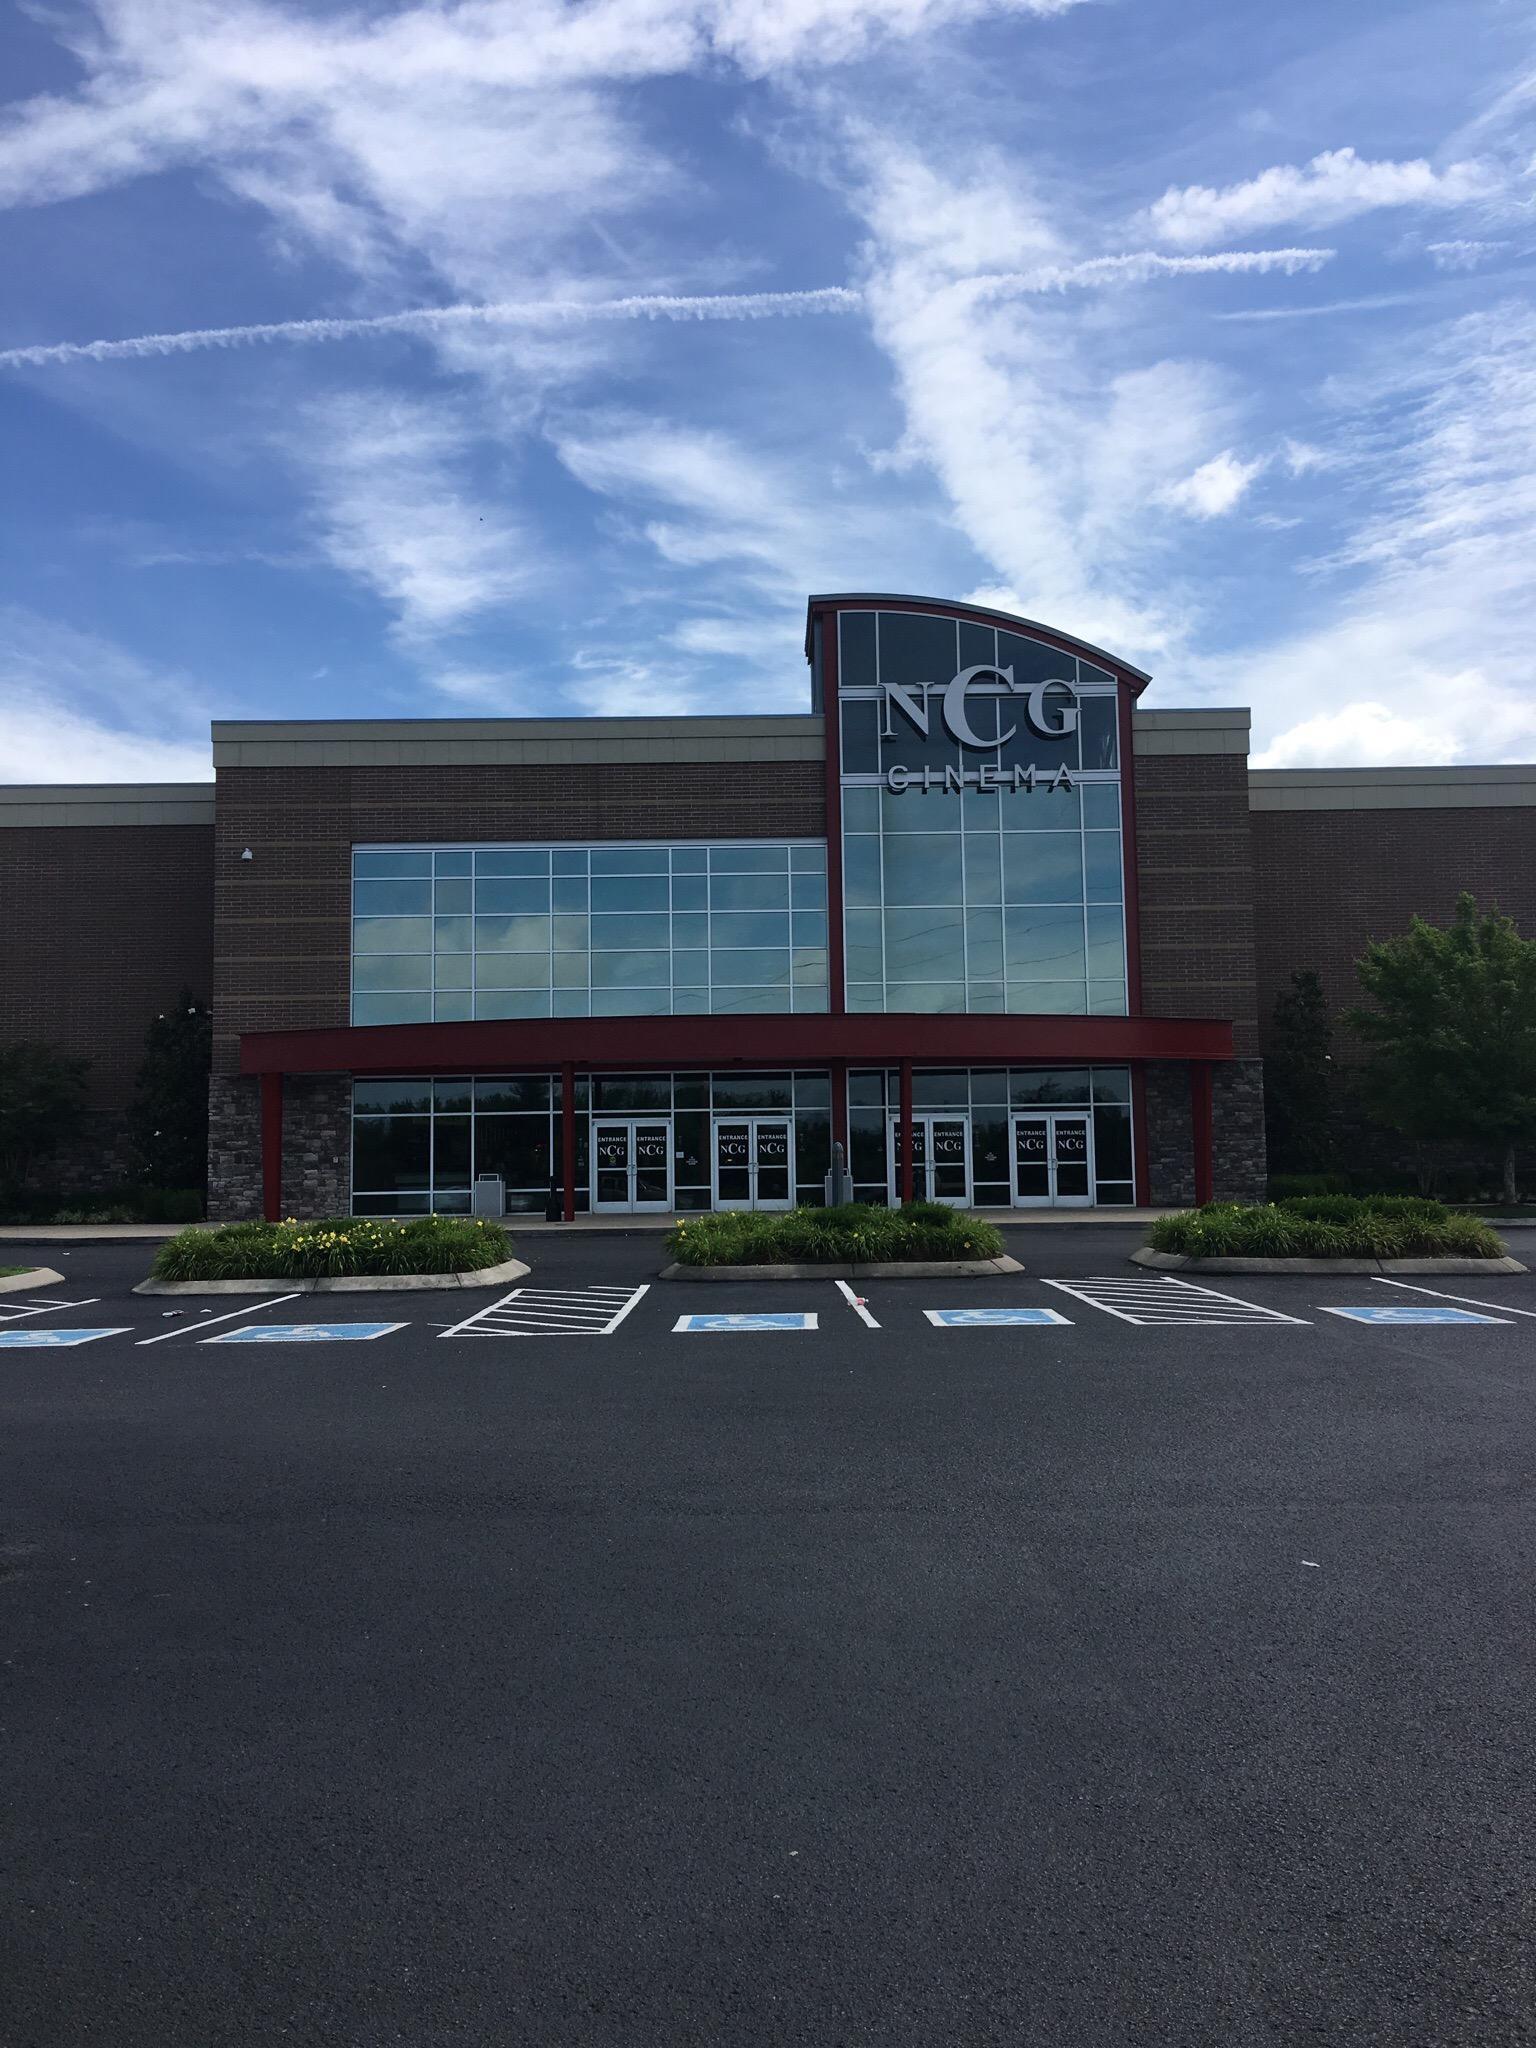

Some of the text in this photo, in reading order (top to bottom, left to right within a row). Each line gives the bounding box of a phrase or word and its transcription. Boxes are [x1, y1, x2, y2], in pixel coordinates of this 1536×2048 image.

[878, 664, 1082, 747] NCG
[887, 762, 1077, 789] CINEMA
[599, 1144, 625, 1156] NCG
[638, 1144, 664, 1156] NCG
[720, 1142, 746, 1154] NCG
[759, 1142, 785, 1154] NCG
[936, 1139, 962, 1151] NCG
[1018, 1138, 1044, 1150] NCG
[1057, 1138, 1084, 1150] NCG
